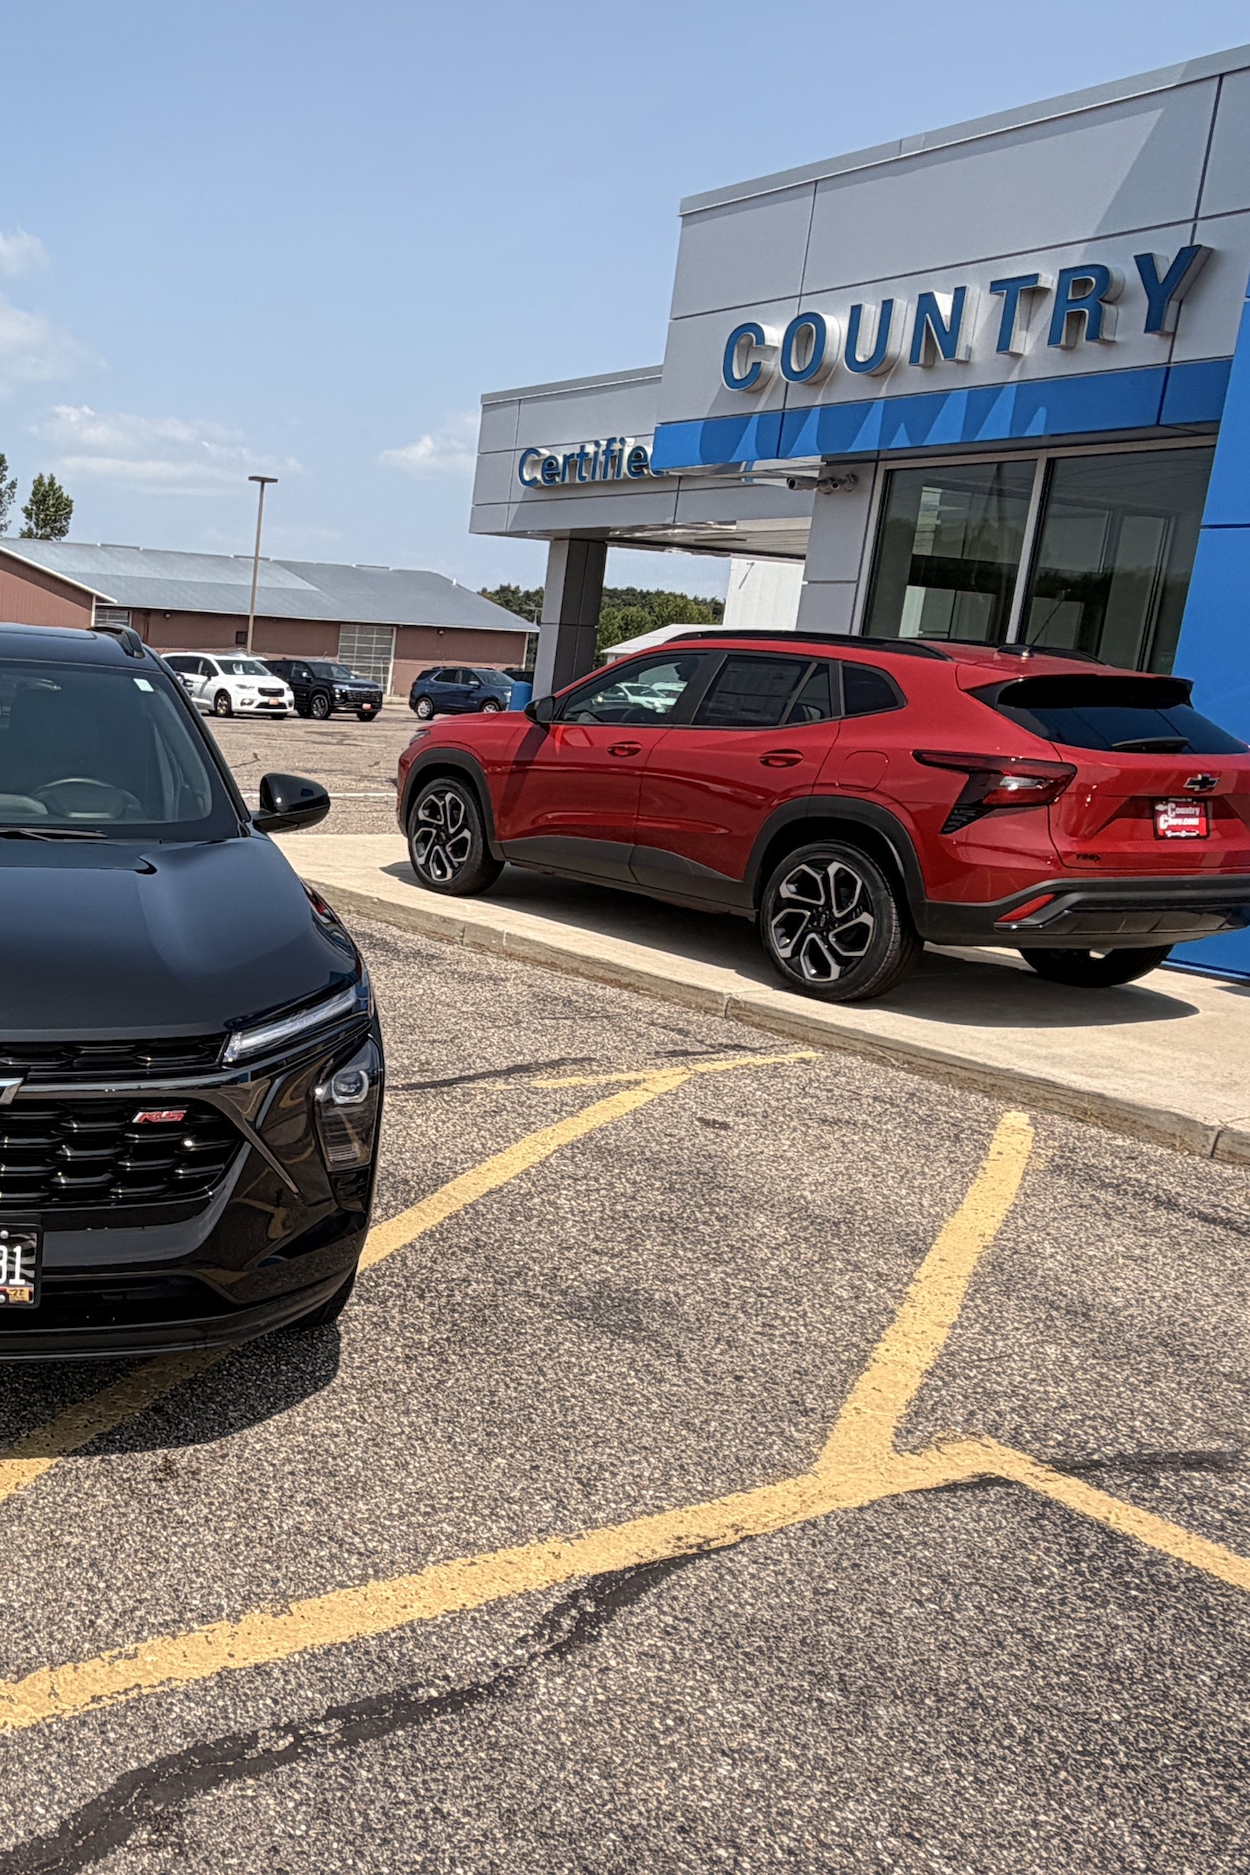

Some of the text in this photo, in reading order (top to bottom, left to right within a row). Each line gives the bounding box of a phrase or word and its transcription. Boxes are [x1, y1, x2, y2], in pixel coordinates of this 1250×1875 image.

[722, 244, 1213, 393] COUNTRY
[1167, 802, 1200, 817] Country
[132, 1109, 187, 1124] RS
